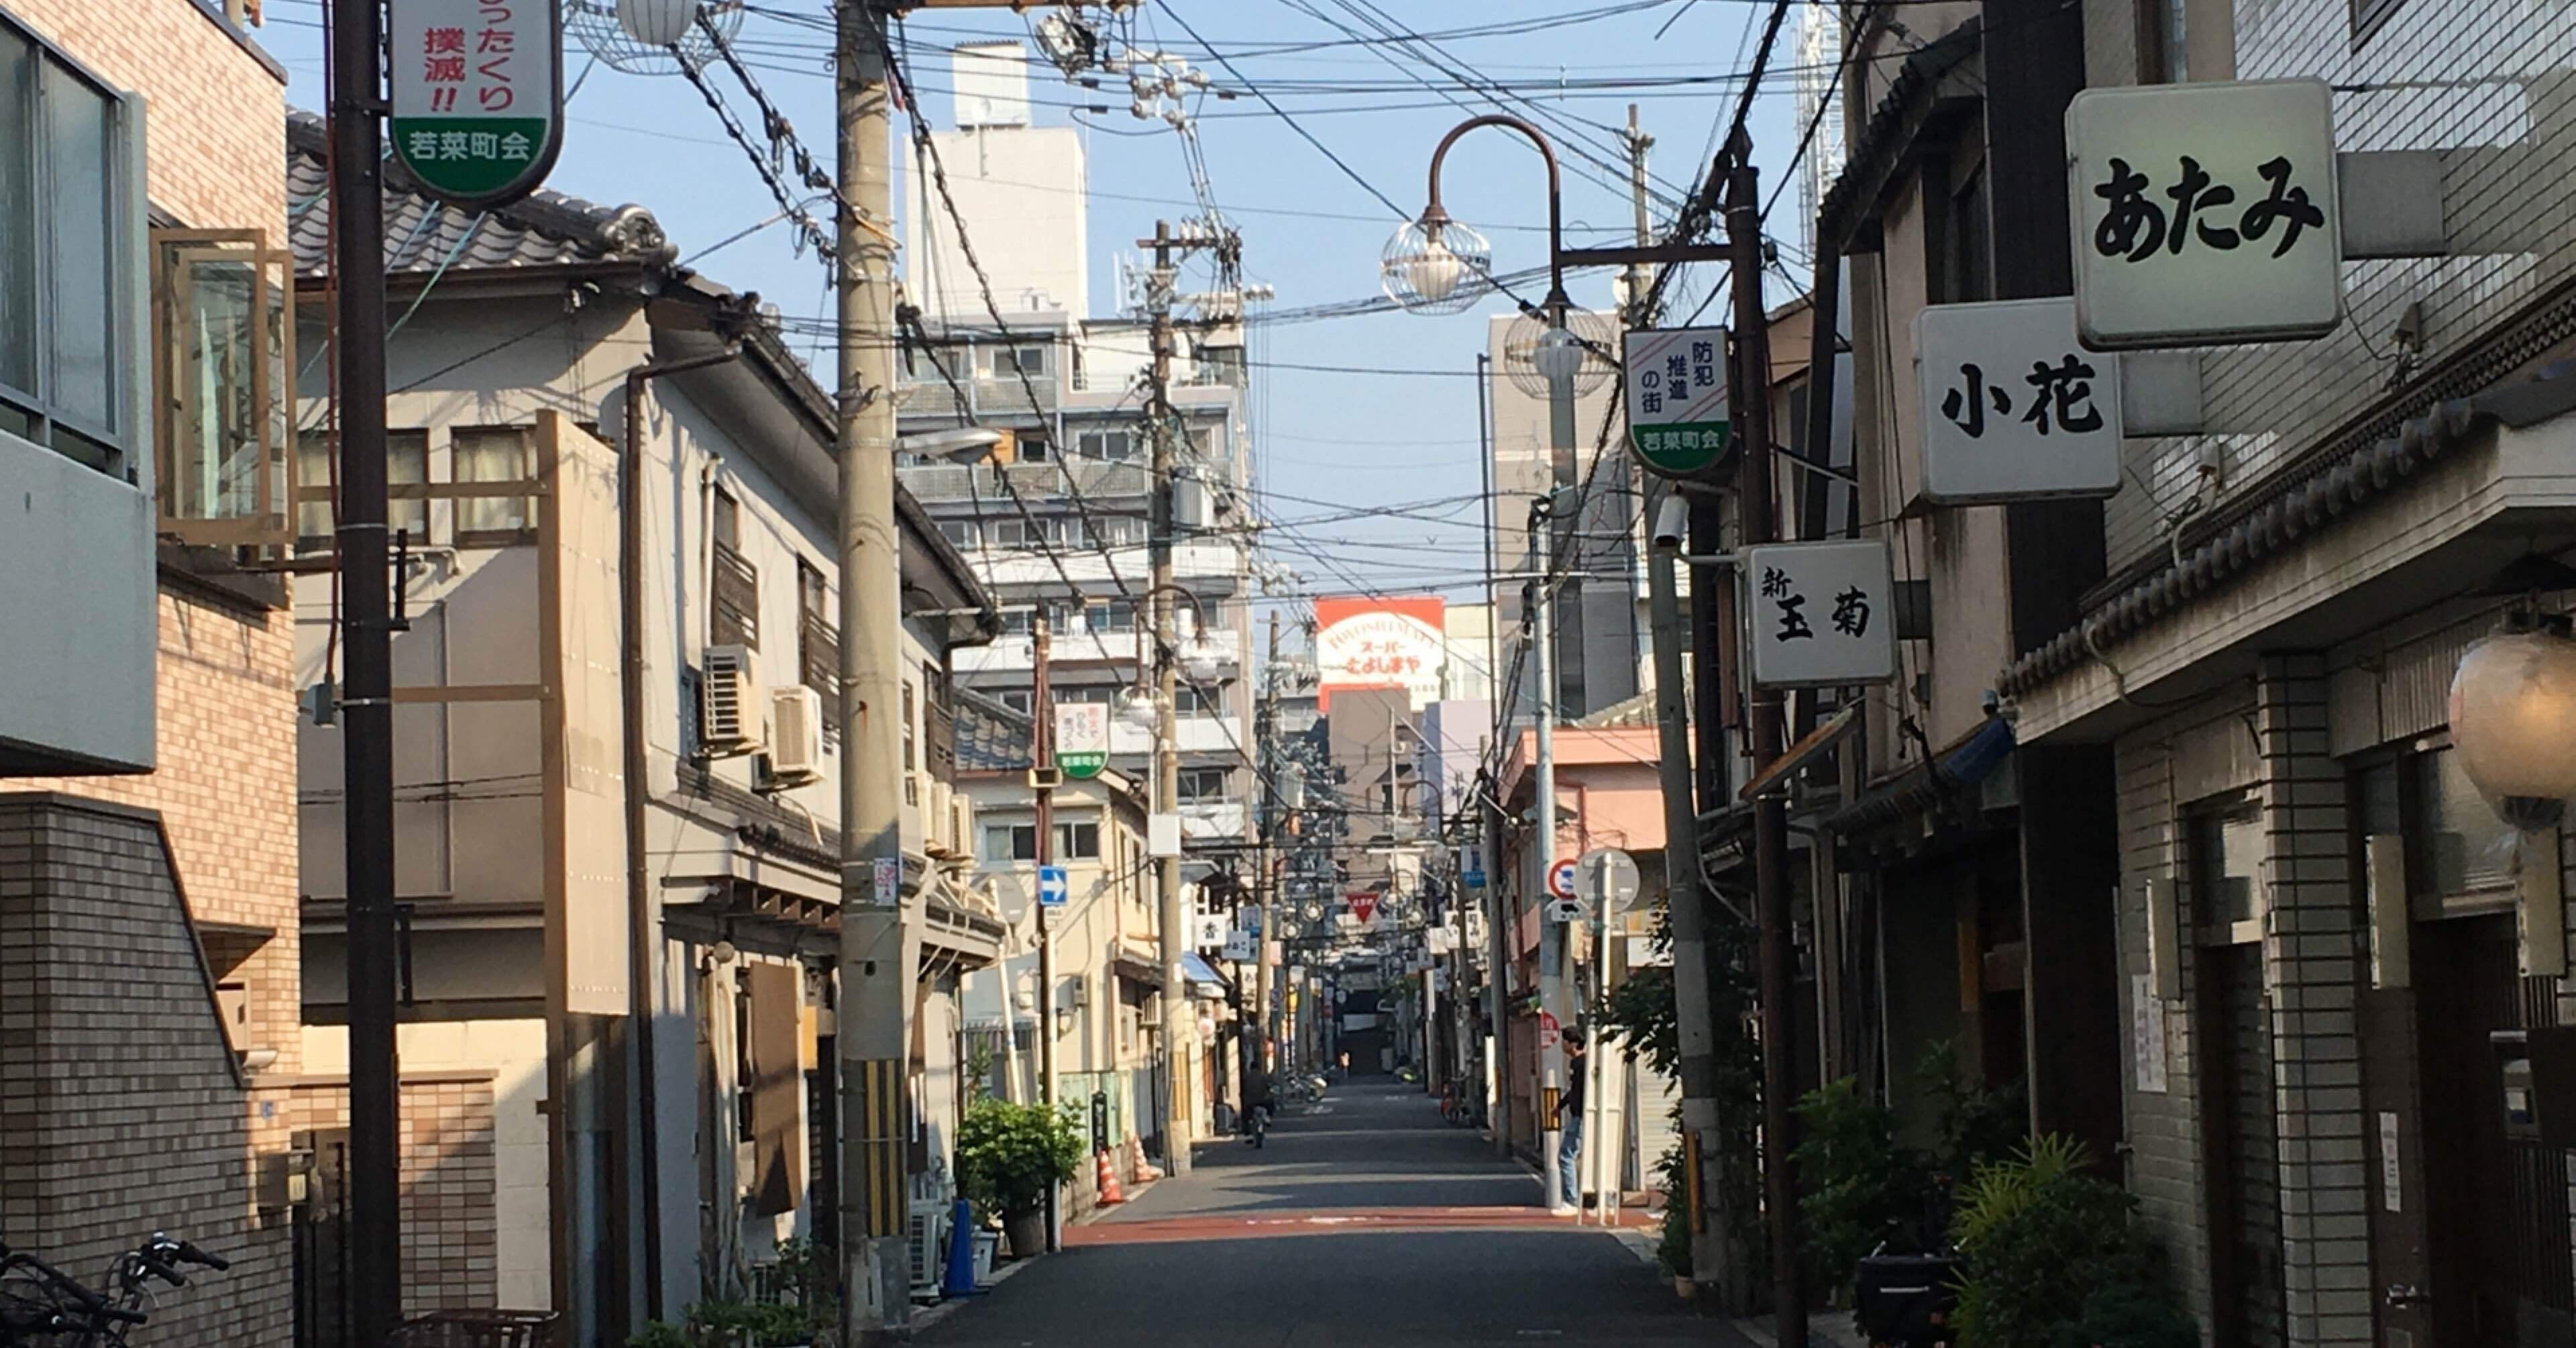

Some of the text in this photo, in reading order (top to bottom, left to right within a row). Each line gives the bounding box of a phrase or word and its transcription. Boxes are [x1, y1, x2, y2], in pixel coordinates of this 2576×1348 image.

[477, 0, 515, 111] ったくり
[409, 131, 529, 162] 若菜町会
[2094, 155, 2325, 262] あたみ
[1666, 354, 1688, 401] 推進
[1692, 341, 1715, 386] 防犯
[1642, 370, 1662, 414] の街
[1941, 354, 2104, 438] 小花
[1644, 429, 1720, 452] 若菜町会
[1762, 566, 1792, 598] 新
[1346, 656, 1421, 674] とよしまや
[1360, 641, 1407, 654] スーパー
